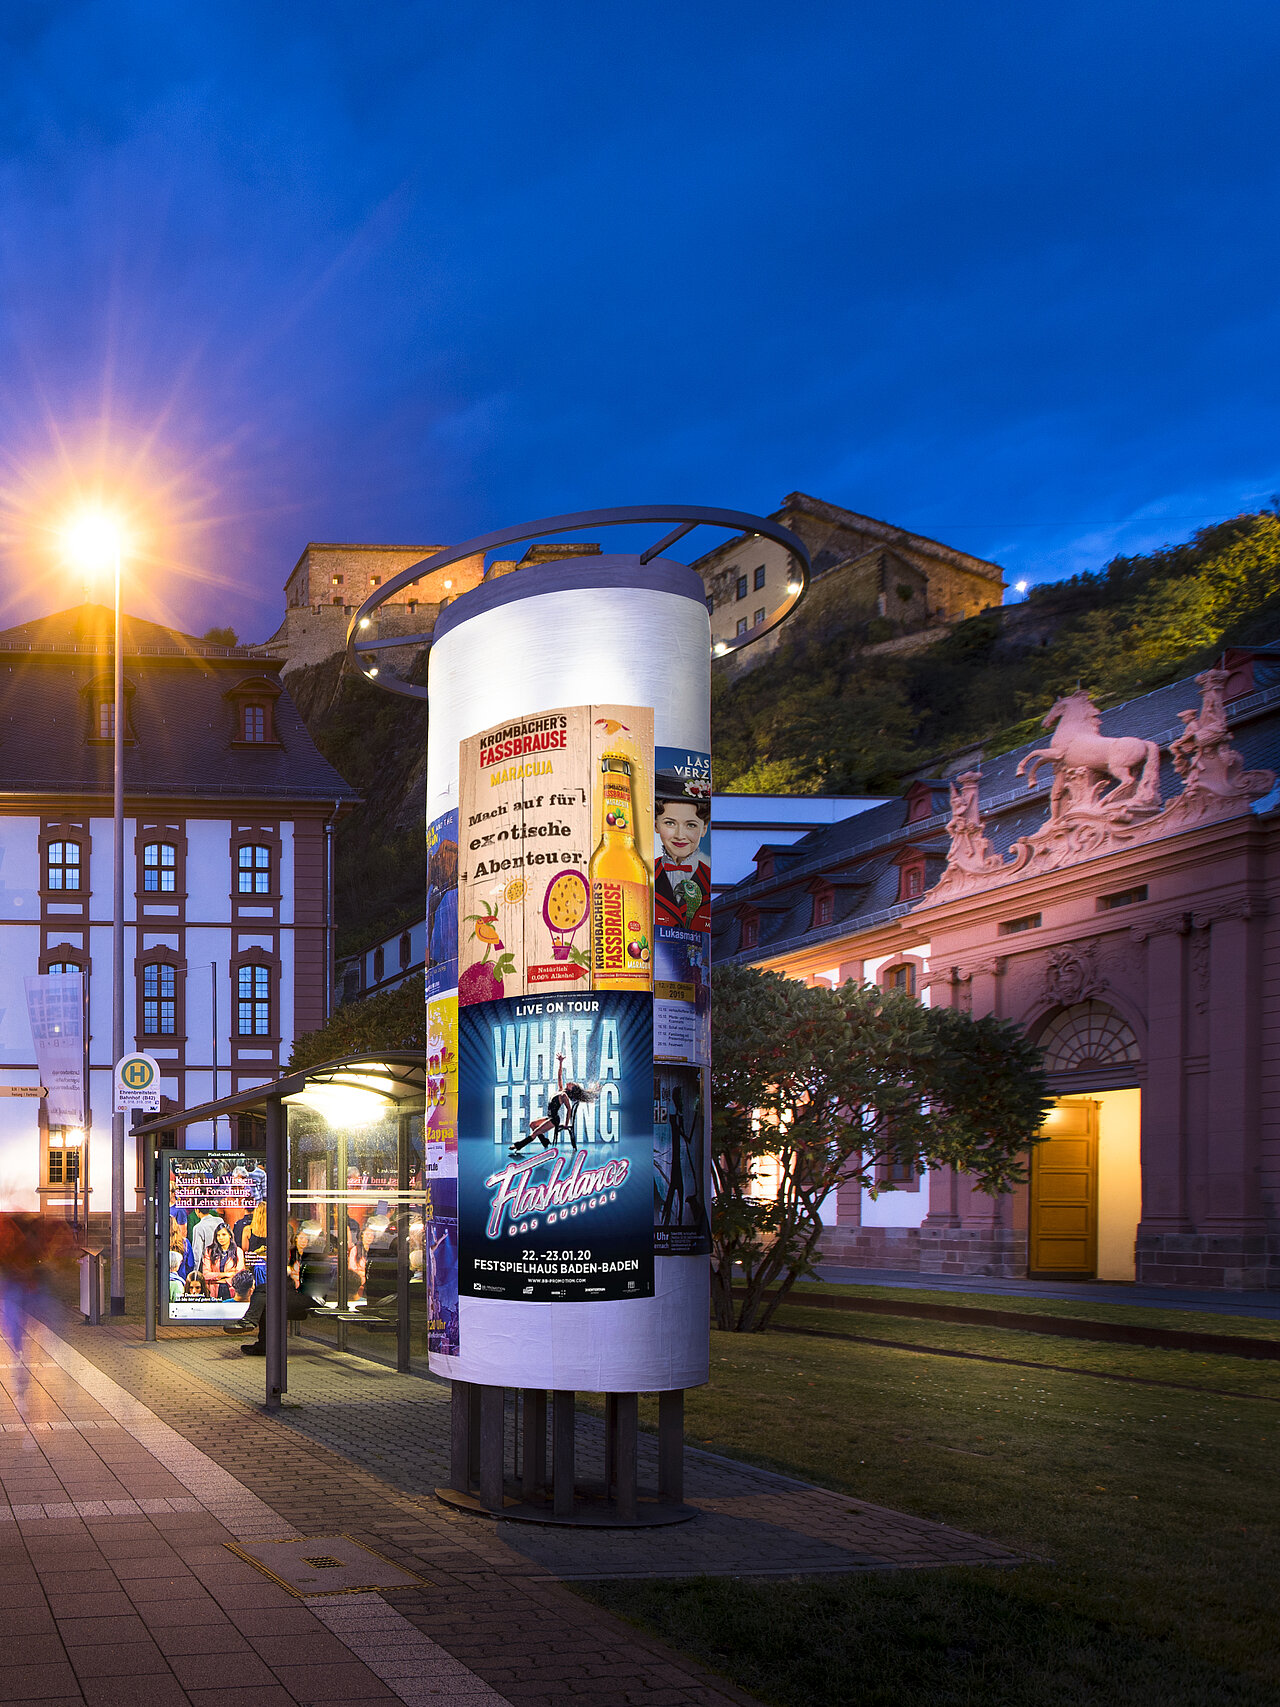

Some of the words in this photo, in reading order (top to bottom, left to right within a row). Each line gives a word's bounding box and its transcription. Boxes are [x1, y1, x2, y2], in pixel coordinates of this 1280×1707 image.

[480, 716, 567, 750] KROMBACHER'S
[480, 730, 566, 768] FASSBRAUSE
[490, 760, 553, 787] MARACUJA
[468, 804, 507, 827] Mach
[513, 796, 543, 811] auf
[549, 794, 576, 806] für
[469, 821, 571, 850] exotische
[474, 851, 587, 879] Abenteuer.
[605, 883, 623, 969] FASSBRAUSE
[669, 990, 685, 998] 2019
[516, 1003, 543, 1016] LIVE
[547, 1003, 564, 1014] ON
[568, 1002, 599, 1012] TOUR
[493, 1019, 593, 1083] WHAT
[599, 1019, 621, 1080] A
[130, 1066, 145, 1082] H
[194, 1198, 219, 1206] Lehre
[220, 1198, 239, 1206] sind
[240, 1198, 257, 1206] frei.
[206, 1187, 251, 1197] Forschung
[485, 1148, 629, 1237] Flashdance
[509, 1219, 538, 1236] DAS
[547, 1191, 617, 1224] MUSICAL
[656, 1231, 669, 1241] Uhr
[474, 1258, 558, 1274] FESTSPIELHAUS
[560, 1259, 639, 1274] BADEN-BADEN
[522, 1250, 538, 1261] 22.
